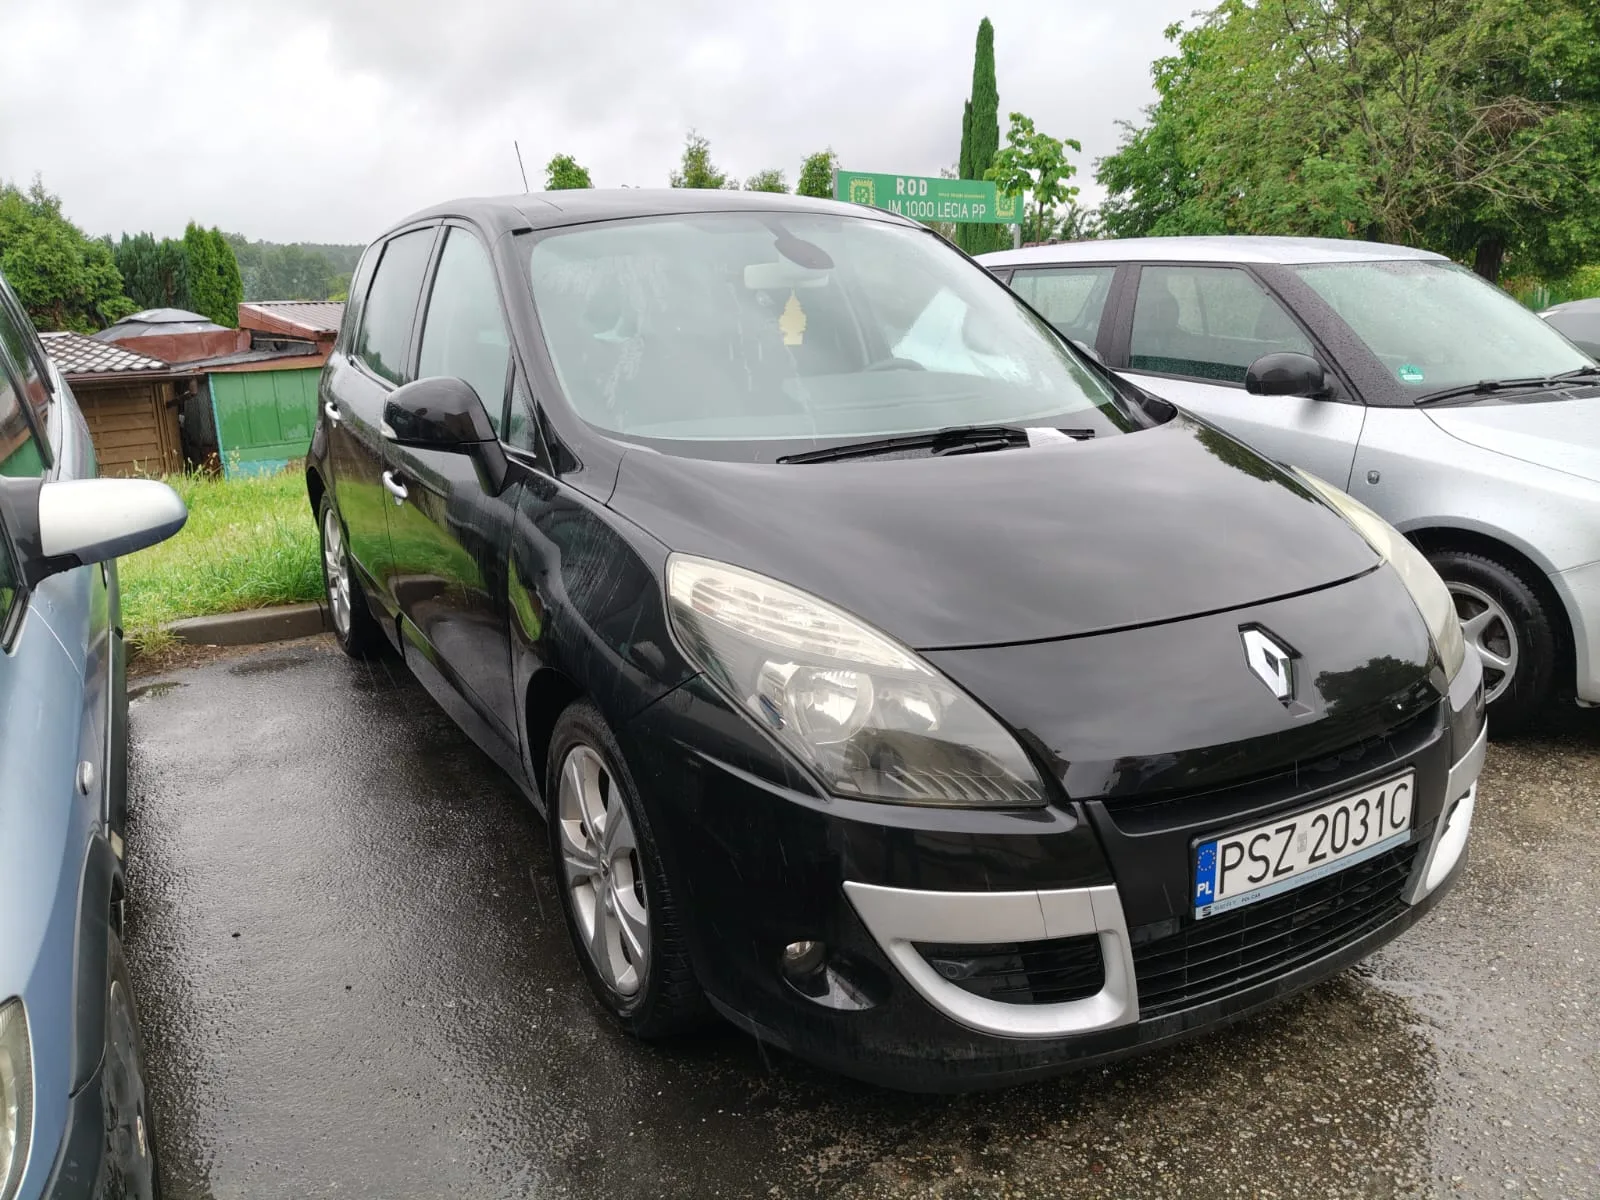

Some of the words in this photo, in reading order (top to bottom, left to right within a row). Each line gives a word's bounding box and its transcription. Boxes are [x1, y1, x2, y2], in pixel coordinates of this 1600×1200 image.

[896, 178, 928, 196] ROD
[905, 200, 934, 218] 1000
[972, 203, 986, 219] PP
[1219, 822, 1297, 895] PSZ
[1308, 782, 1409, 865] 2031C
[1197, 881, 1212, 898] PL
